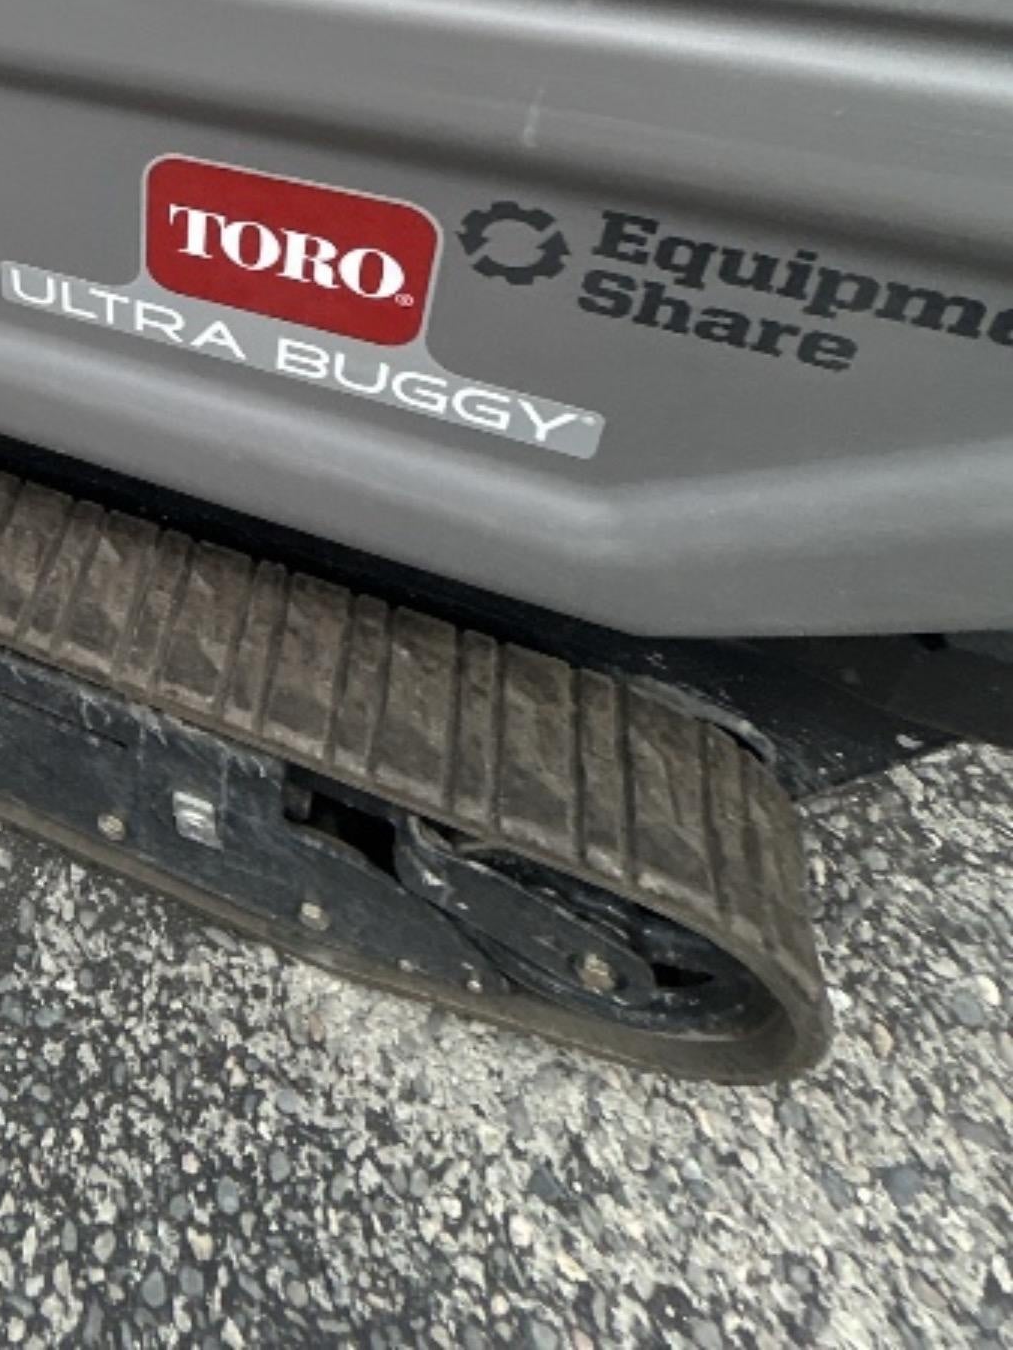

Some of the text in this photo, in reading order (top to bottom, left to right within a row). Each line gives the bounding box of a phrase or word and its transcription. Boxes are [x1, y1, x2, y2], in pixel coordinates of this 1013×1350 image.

[169, 203, 406, 300] TORO
[9, 269, 578, 443] ULTRA BUGGY
[578, 268, 859, 371] Share
